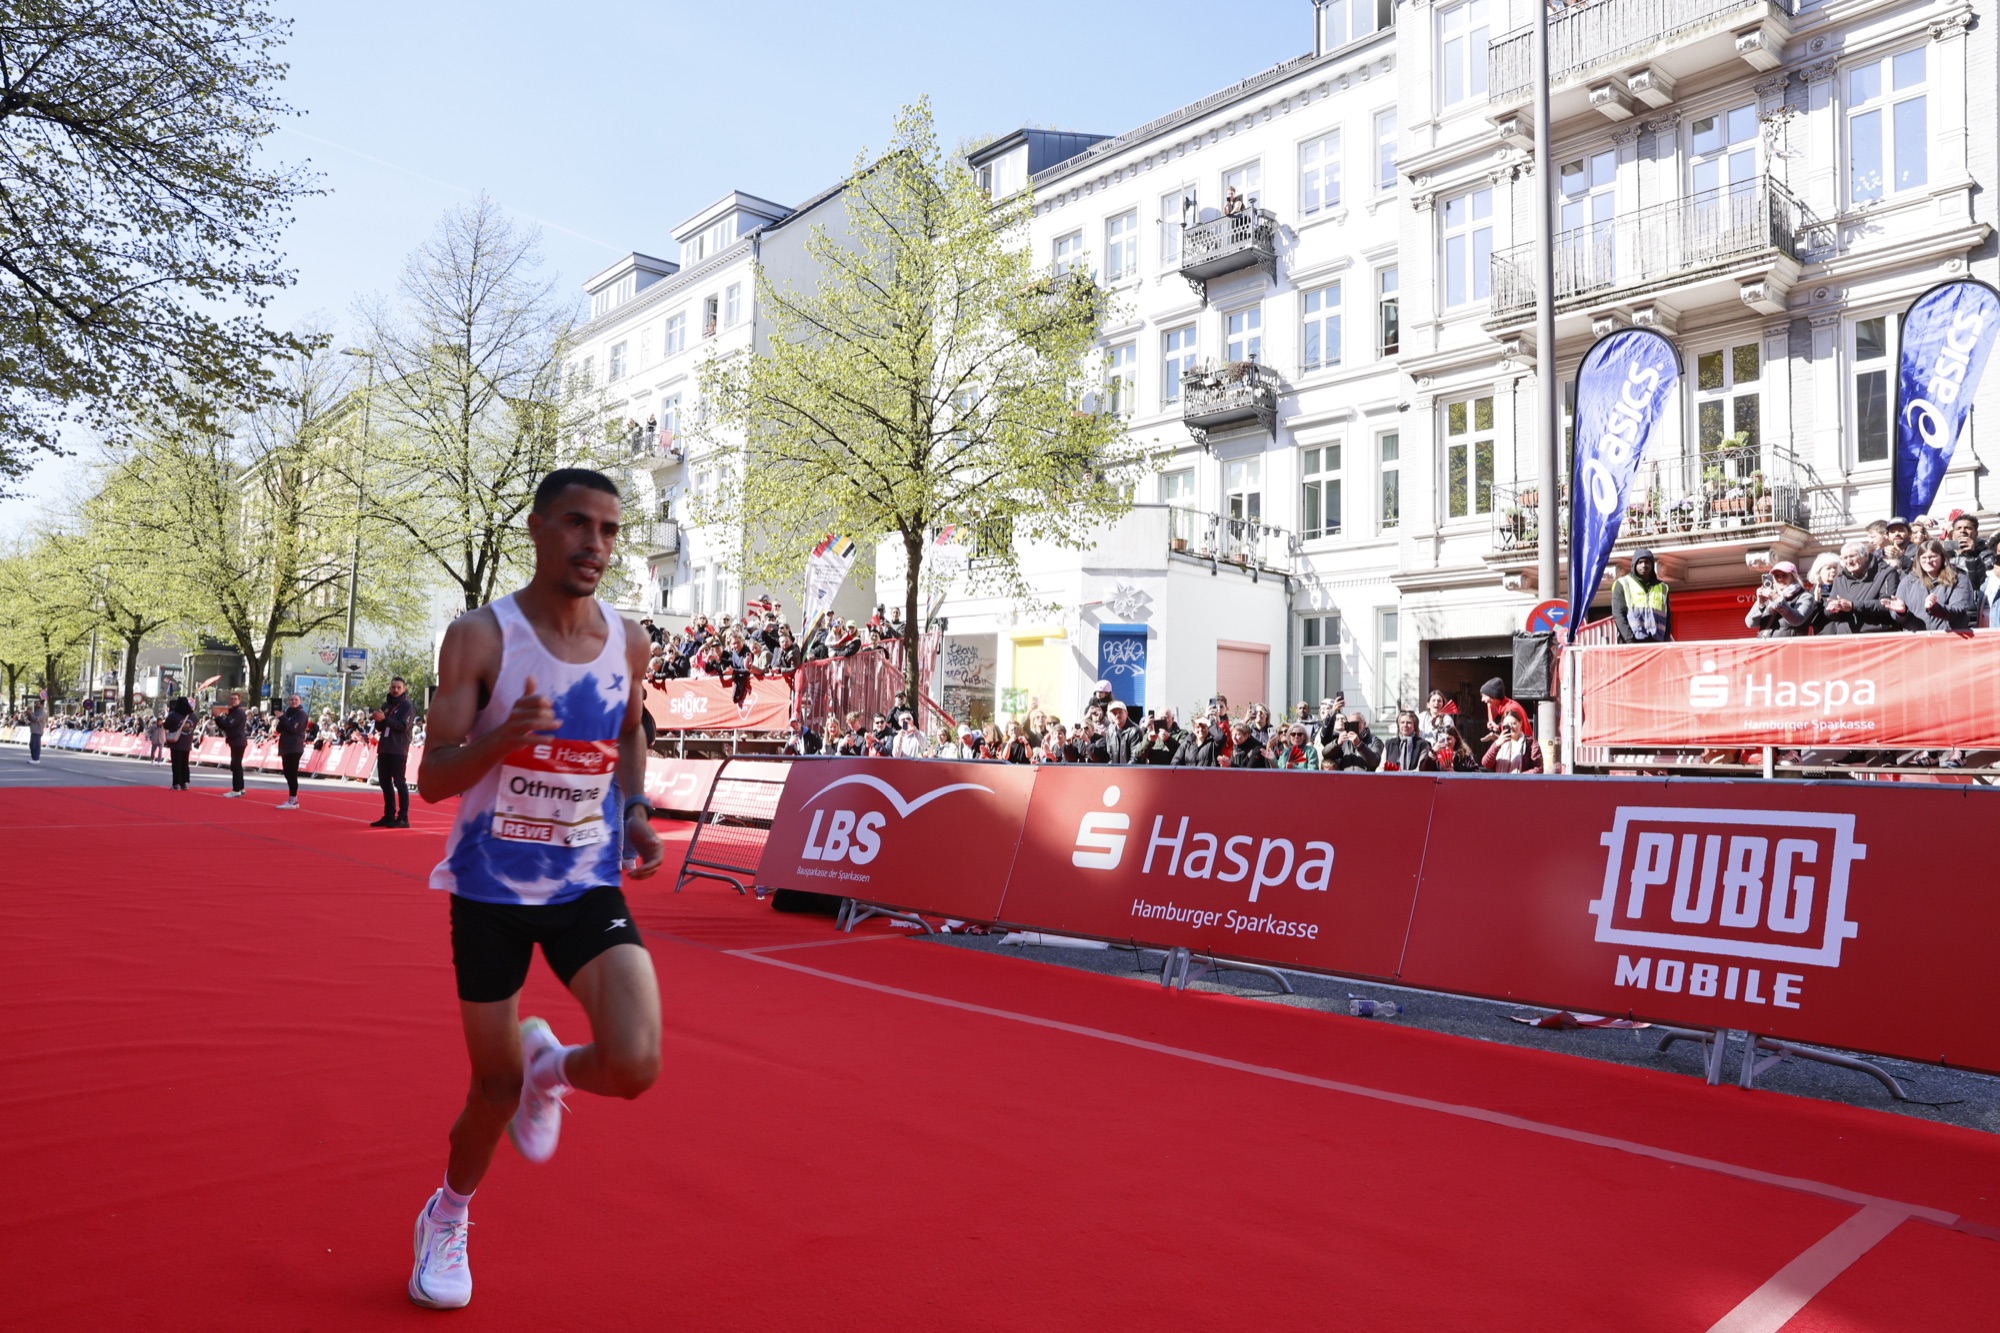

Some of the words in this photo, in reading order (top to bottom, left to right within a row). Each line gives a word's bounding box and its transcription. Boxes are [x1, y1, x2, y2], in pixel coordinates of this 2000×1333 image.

[1927, 310, 1983, 404] asics
[1599, 361, 1659, 464] asics
[669, 697, 708, 713] SHOKZ
[1744, 673, 1876, 715] Haspa
[1743, 719, 1808, 732] Hamburger
[1810, 719, 1875, 731] Sparkasse
[556, 747, 604, 767] Haspa
[503, 822, 551, 839] REWE
[801, 809, 886, 865] LBS
[828, 869, 837, 878] der
[838, 870, 870, 882] Sparkassen
[1142, 814, 1335, 902] Haspa
[1626, 832, 1818, 934] PUBG
[1131, 899, 1222, 928] Hamburger
[1224, 909, 1318, 939] Sparkasse
[1614, 955, 1804, 1009] MOBILE
